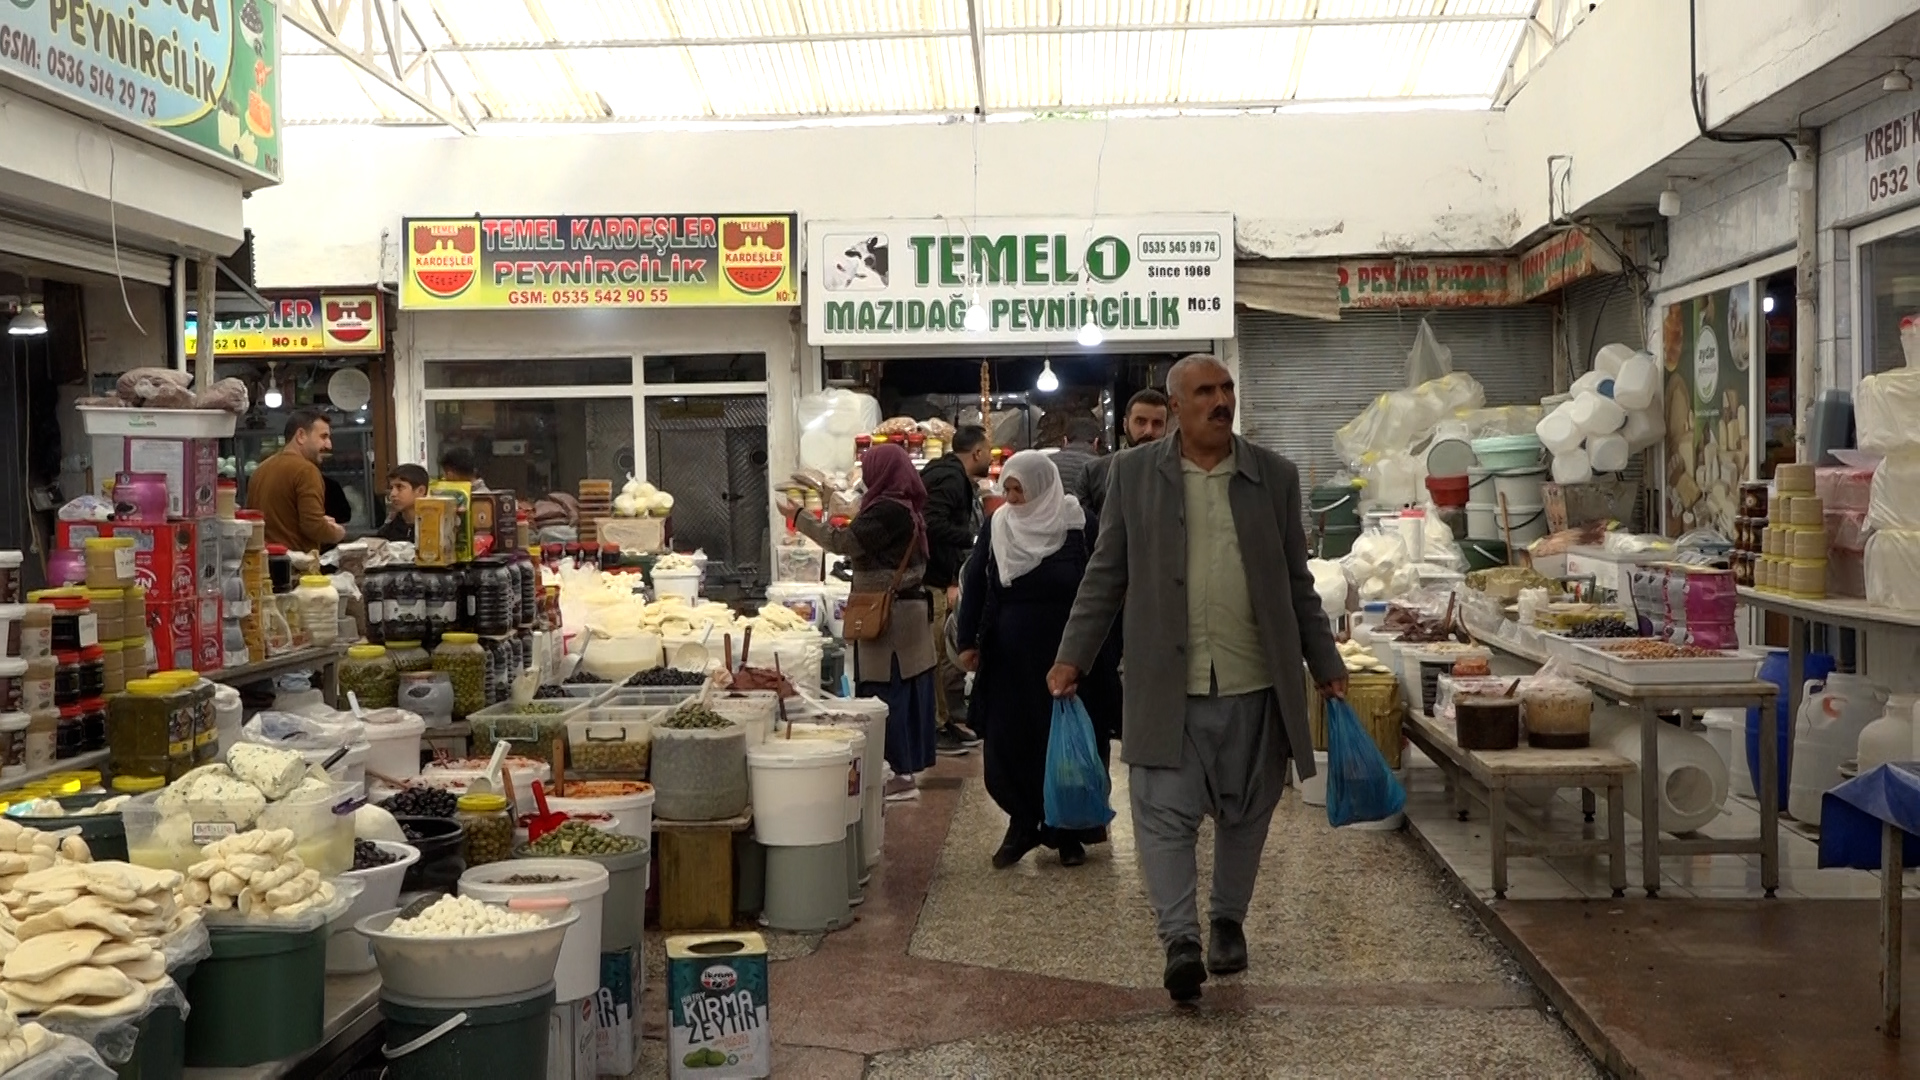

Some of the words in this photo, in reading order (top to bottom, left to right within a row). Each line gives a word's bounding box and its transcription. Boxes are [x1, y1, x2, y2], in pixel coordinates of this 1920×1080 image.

[50, 0, 218, 106] PEYNİRCİLİK
[0, 25, 41, 70] GSM:
[47, 46, 85, 88] 0536
[90, 65, 115, 102] 514
[119, 79, 136, 111] 29
[140, 87, 157, 118] 73
[1870, 165, 1908, 202] 0532
[433, 225, 456, 234] TEMEL
[483, 218, 565, 252] TEMEL
[571, 216, 717, 255] KARDEŞLER
[742, 221, 765, 230] TEMEL
[416, 256, 473, 267] KARDEŞLER
[493, 253, 707, 286] PEYNİRCİLİK
[725, 252, 783, 263] KARDEŞLER
[908, 235, 1079, 286] TEMEL
[1148, 265, 1181, 278] Since
[508, 290, 547, 304] GSM:
[552, 290, 589, 304] 0535
[594, 289, 622, 303] 542
[627, 289, 645, 303] 90
[650, 289, 668, 302] 55
[824, 293, 976, 334] MAZIDAĞ
[682, 989, 754, 1027] KIRMA
